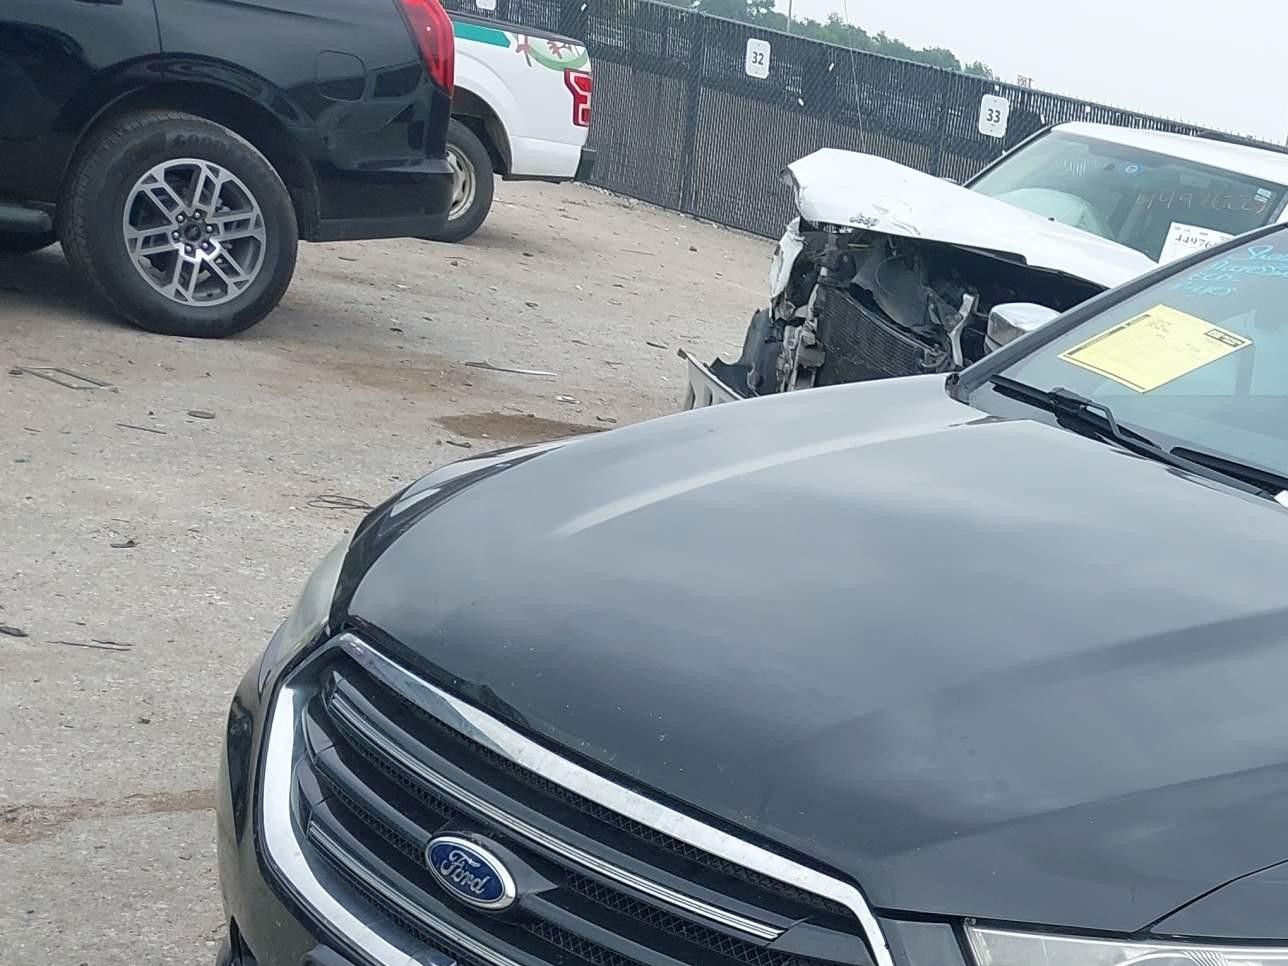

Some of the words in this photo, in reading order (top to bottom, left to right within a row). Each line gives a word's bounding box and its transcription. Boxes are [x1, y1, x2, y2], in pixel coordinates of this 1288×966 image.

[751, 51, 765, 66] 32
[986, 108, 1001, 124] 33
[440, 849, 491, 895] Ford
